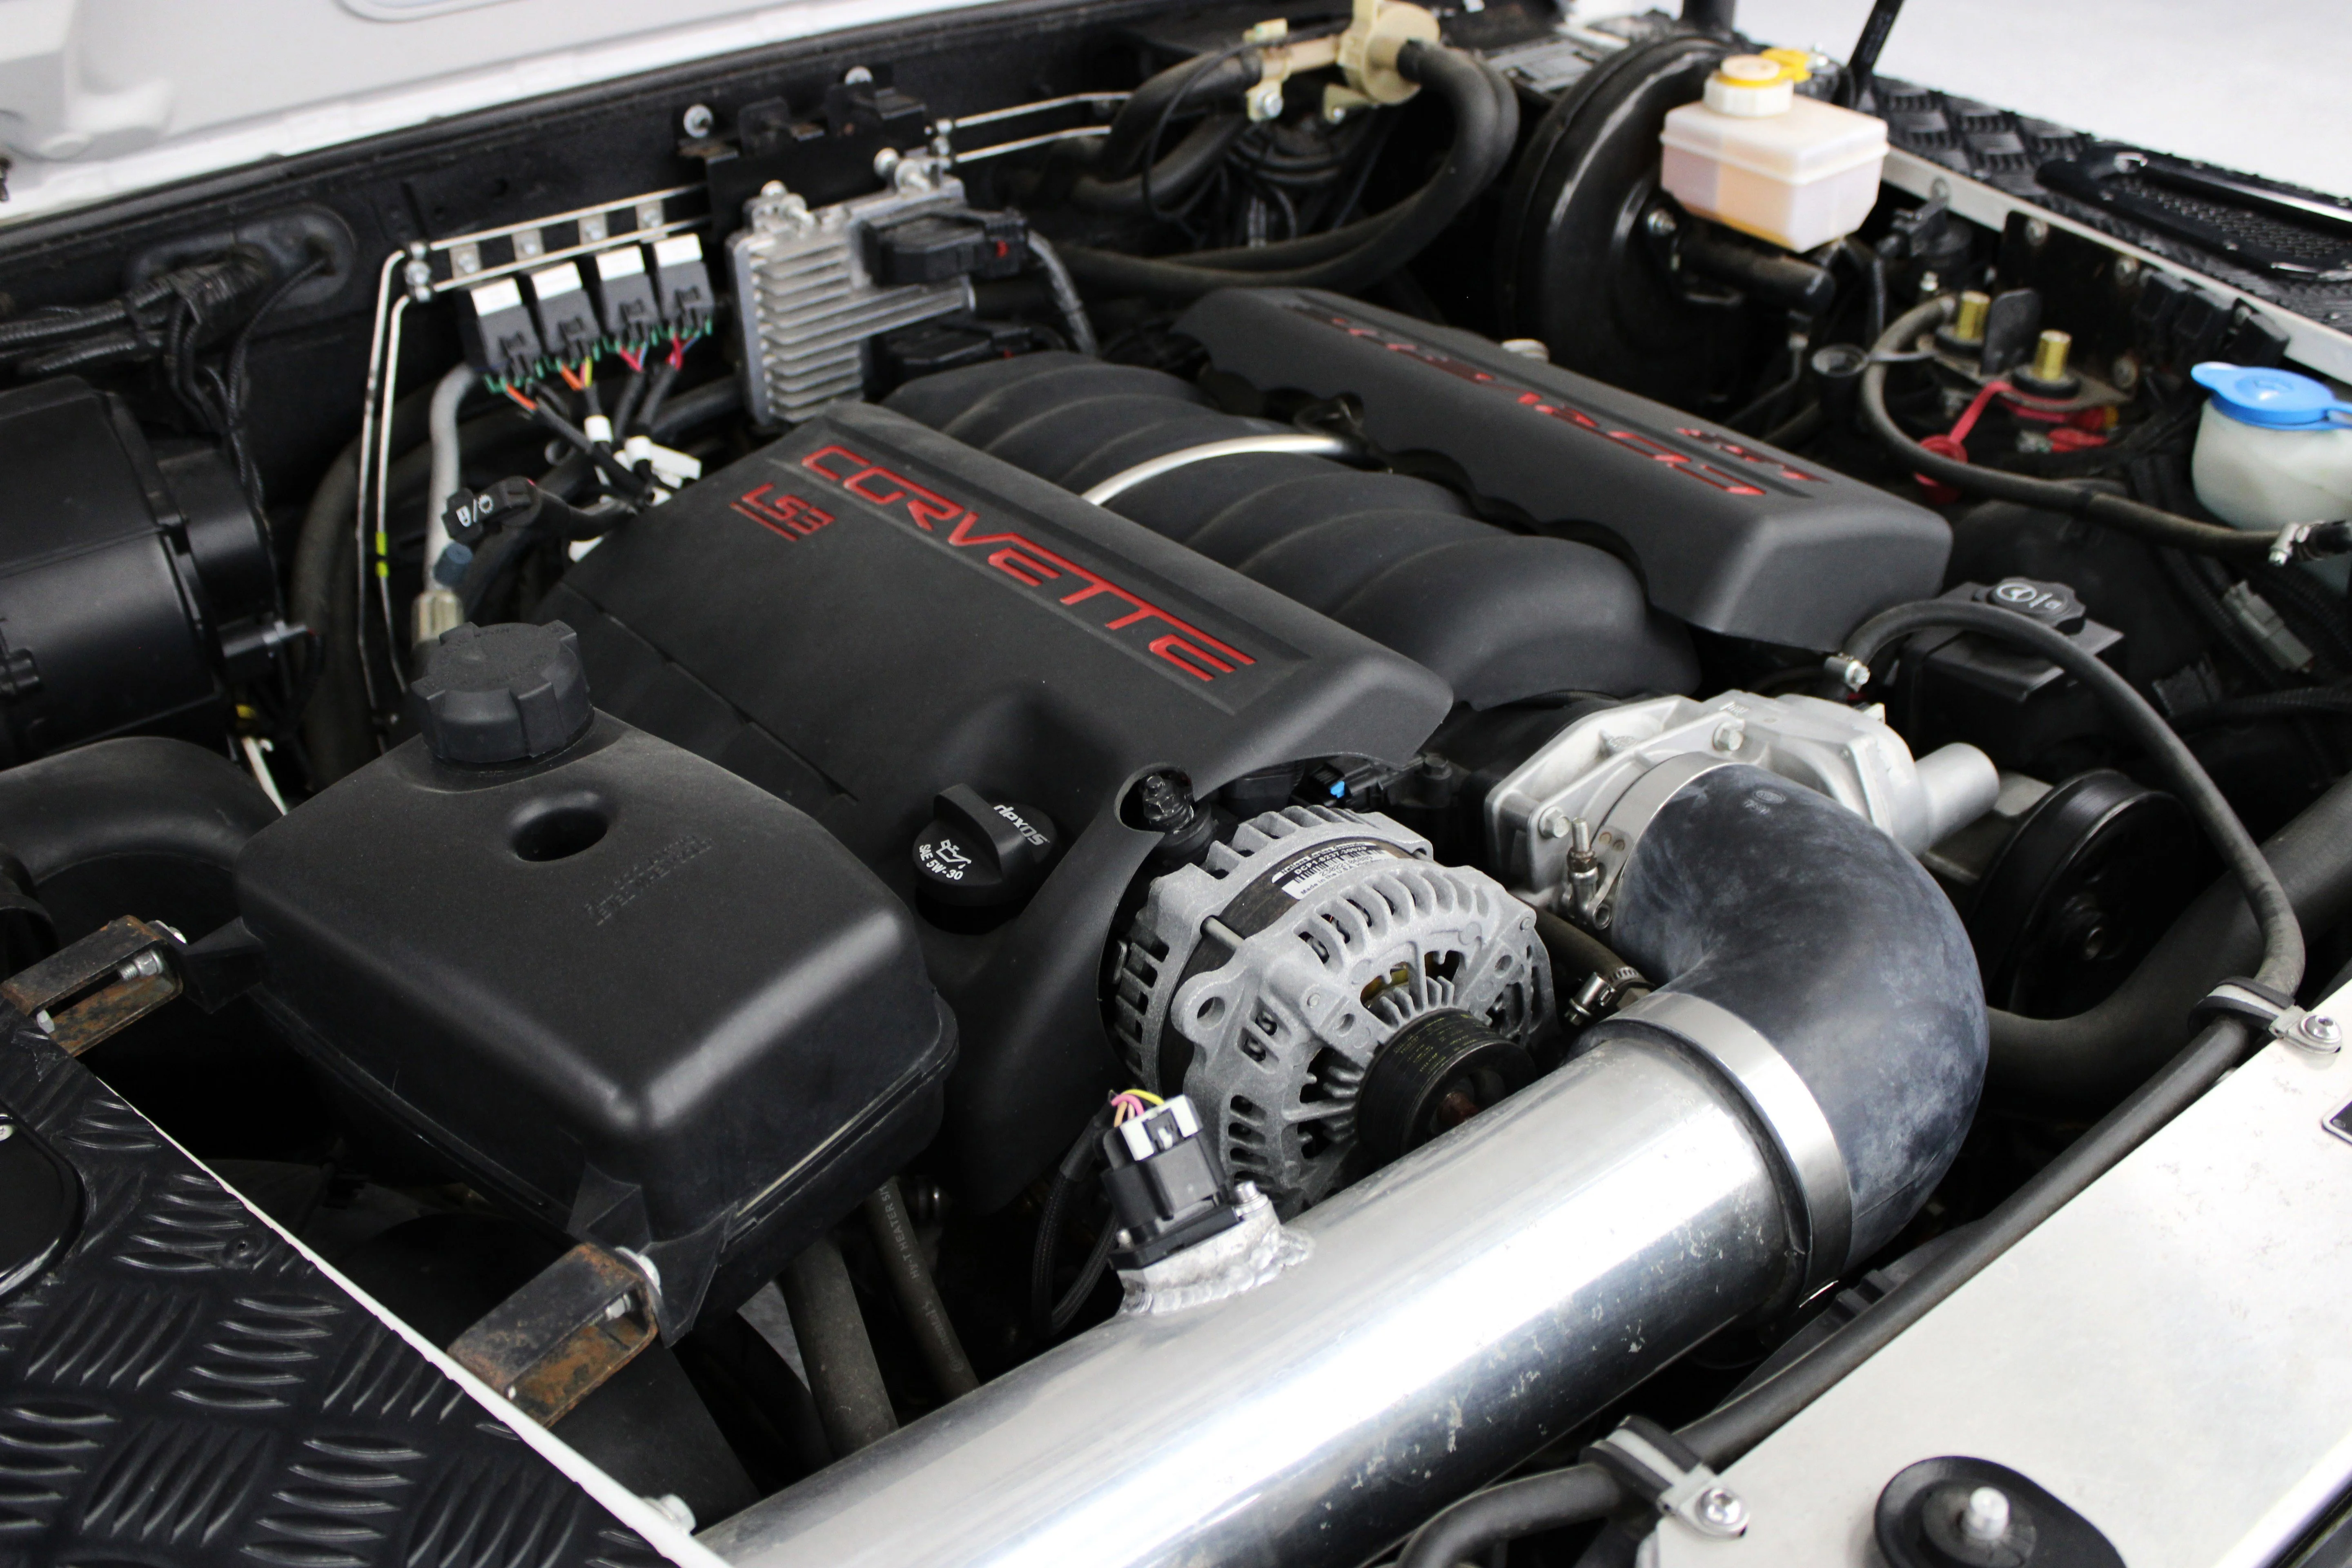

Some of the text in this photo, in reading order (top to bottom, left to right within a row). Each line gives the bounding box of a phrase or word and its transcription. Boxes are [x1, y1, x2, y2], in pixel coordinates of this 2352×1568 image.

[741, 481, 837, 535] LS3
[801, 445, 1256, 681] CORVETTE
[919, 844, 964, 880] SAE 5W-30
[1300, 883, 1319, 895] Made
[884, 1202, 908, 1251] HEATER
